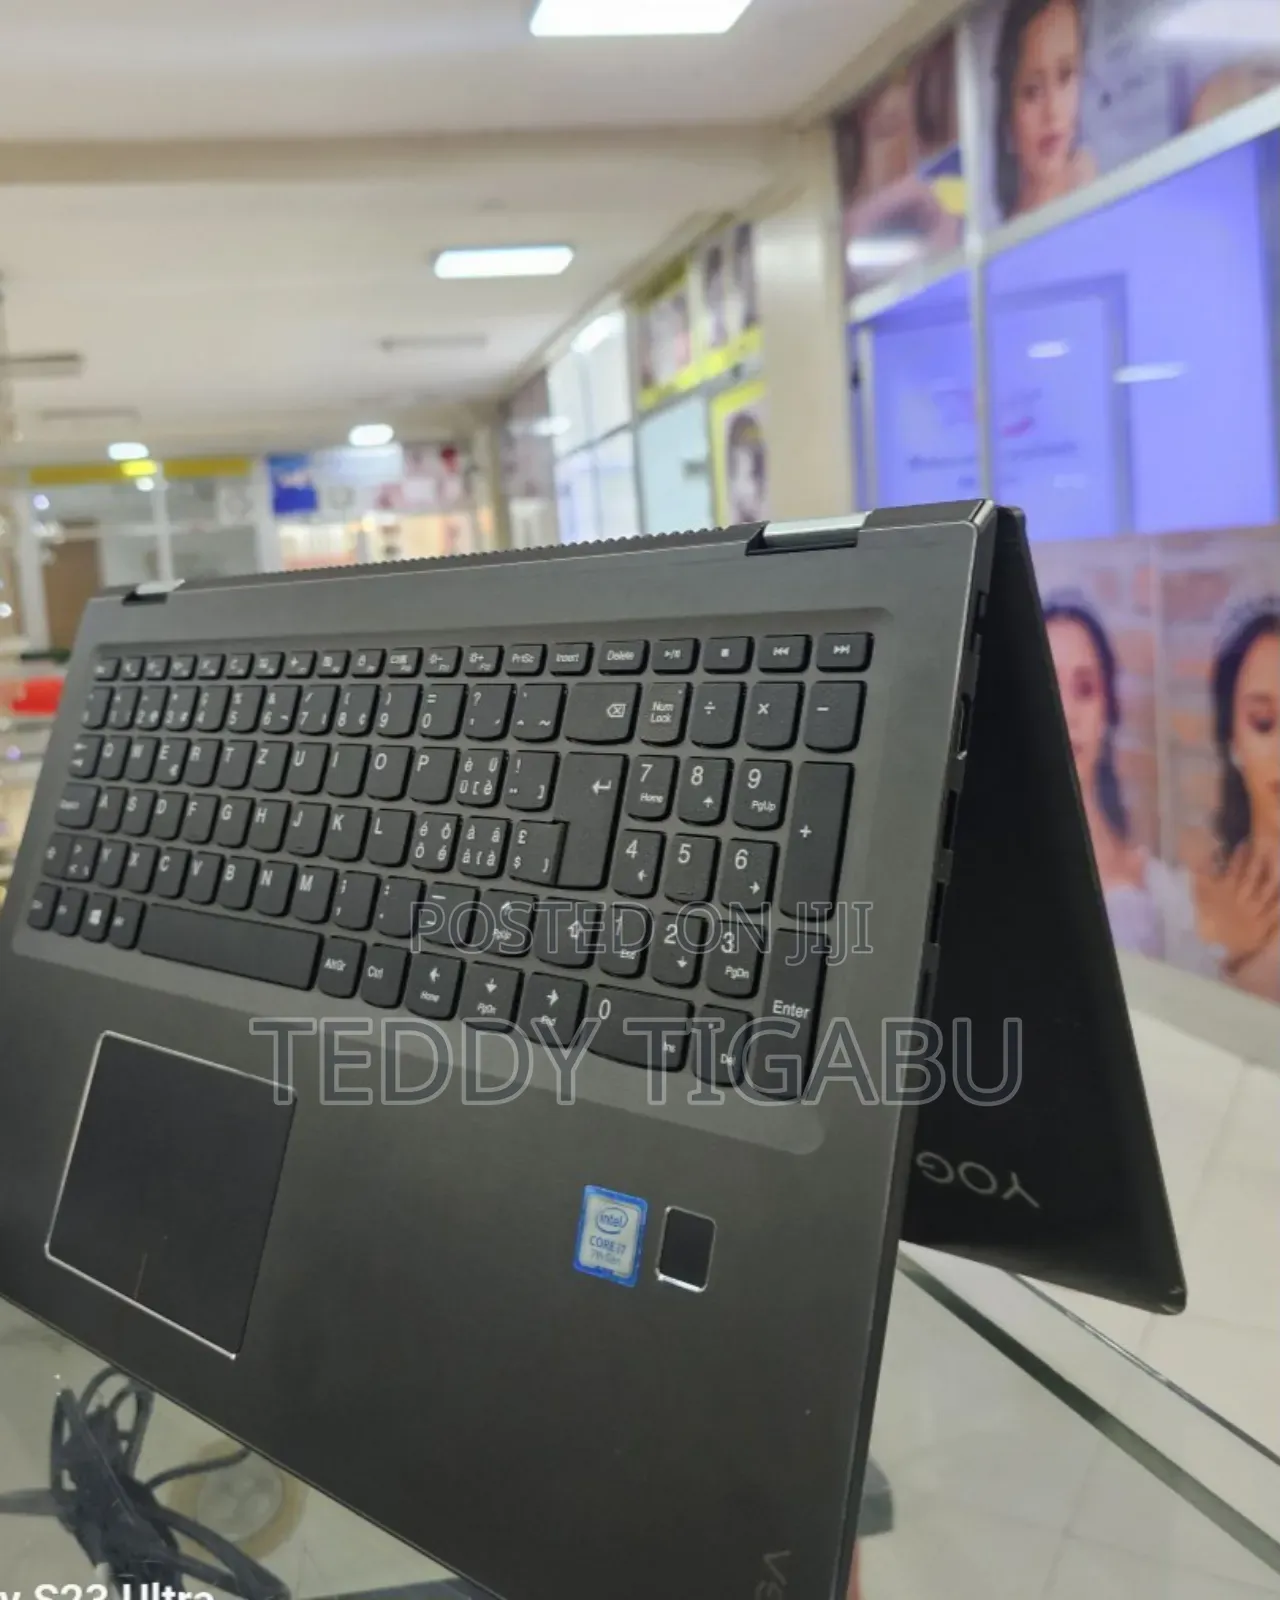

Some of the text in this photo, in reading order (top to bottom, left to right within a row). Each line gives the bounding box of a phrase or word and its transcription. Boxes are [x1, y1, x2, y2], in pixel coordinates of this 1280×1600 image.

[511, 653, 535, 664] PrtSc
[606, 650, 635, 661] Delete
[652, 702, 674, 713] Num
[229, 711, 238, 725] 5
[263, 712, 272, 725] 6
[300, 712, 309, 725] 7
[337, 712, 347, 727] 8
[379, 713, 389, 728] 9
[422, 714, 431, 728] 0
[650, 713, 672, 724] Lock
[160, 745, 170, 760] E
[190, 747, 201, 761] R
[224, 748, 235, 763] T
[257, 749, 269, 764] Z
[294, 751, 306, 766] U
[332, 752, 339, 767] I
[375, 753, 387, 770] O
[417, 755, 430, 772] P
[640, 763, 653, 782] 7
[690, 765, 704, 786] 8
[747, 768, 762, 789] 9
[127, 797, 138, 811] S
[640, 792, 664, 804] Home
[156, 800, 167, 814] D
[187, 801, 198, 816] F
[221, 804, 233, 820] G
[751, 800, 776, 814] PgUp
[255, 808, 268, 823] H
[293, 811, 303, 827] J
[332, 814, 345, 831] K
[374, 818, 383, 835] L
[625, 839, 639, 859] 4
[677, 843, 692, 864] 5
[128, 852, 140, 867] X
[159, 856, 171, 872] C
[734, 848, 749, 870] 6
[193, 860, 203, 875] V
[224, 865, 236, 881] B
[260, 870, 273, 886] N
[300, 874, 314, 892] M
[664, 924, 678, 945] 2
[721, 931, 735, 953] 3
[367, 966, 384, 980] Ctrl
[725, 964, 750, 979] PgDn
[599, 999, 611, 1020] 0
[772, 1000, 811, 1020] Enter
